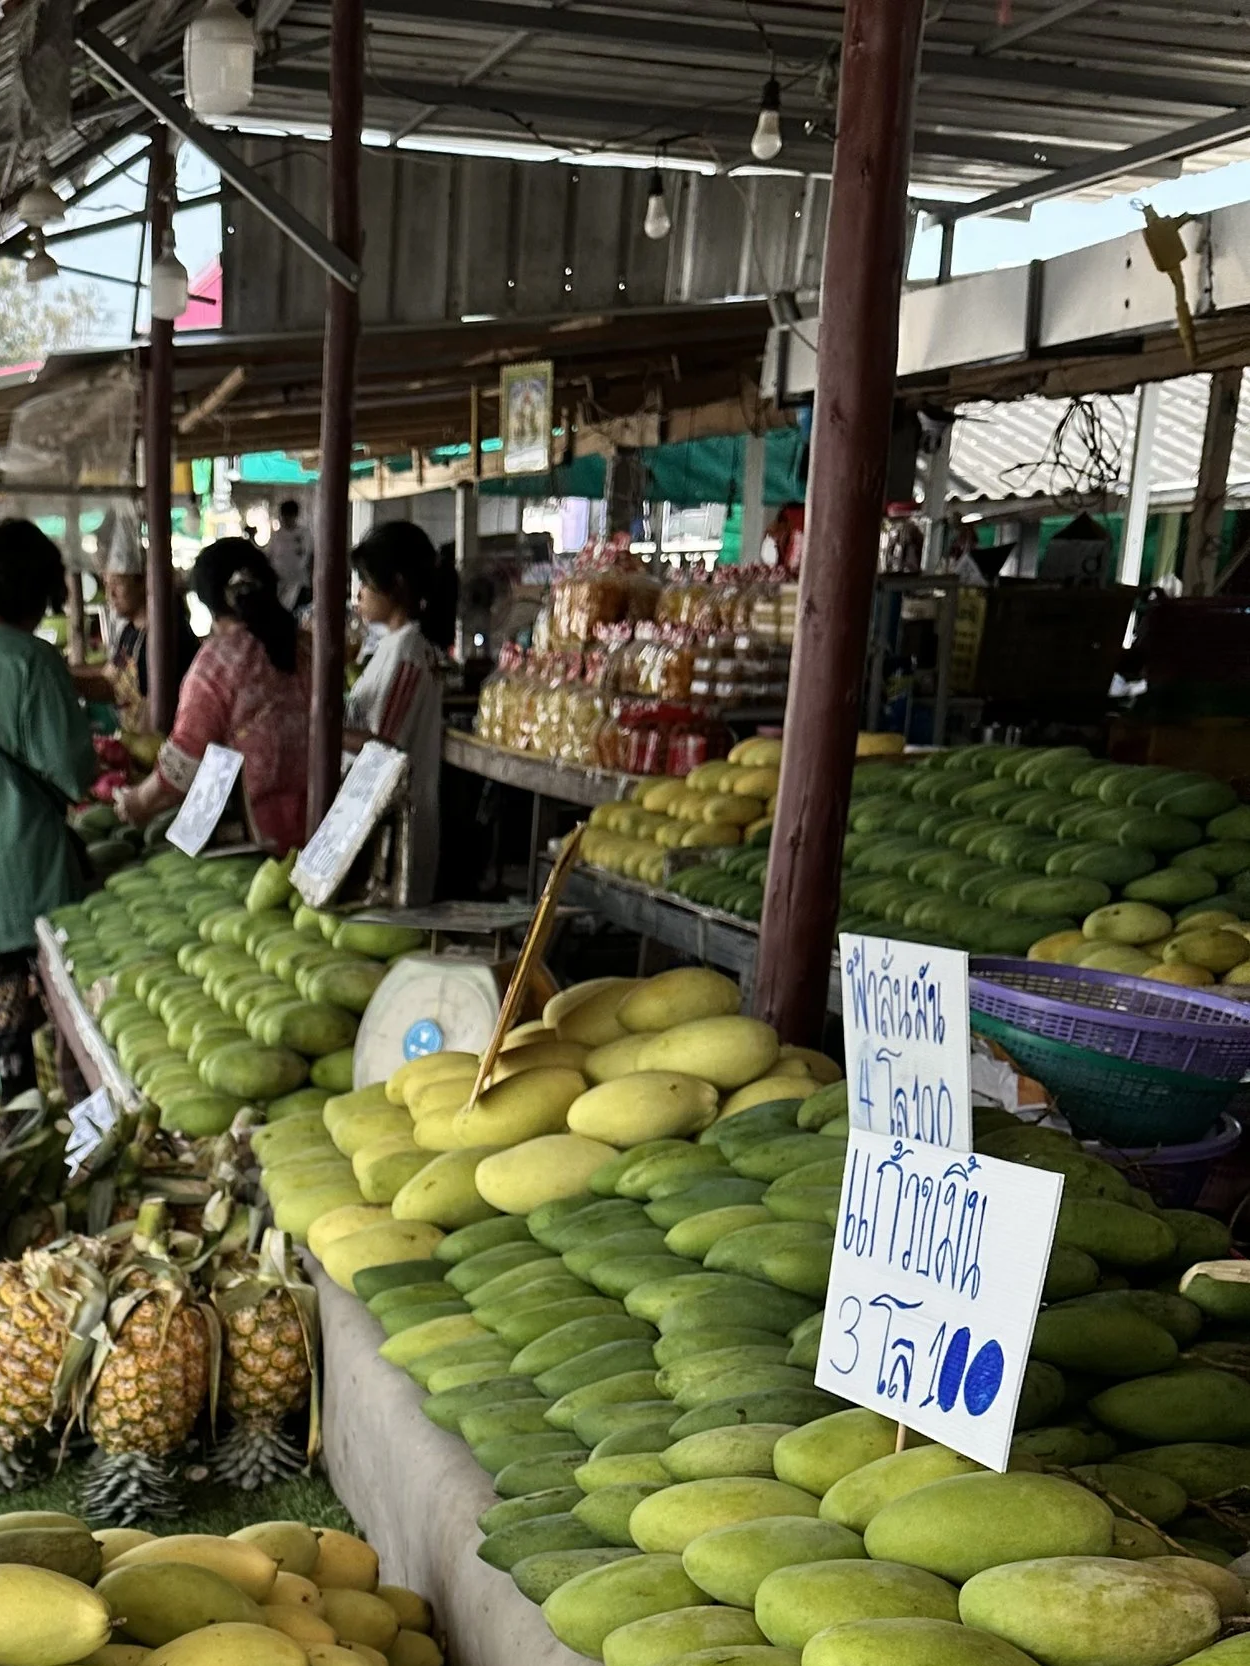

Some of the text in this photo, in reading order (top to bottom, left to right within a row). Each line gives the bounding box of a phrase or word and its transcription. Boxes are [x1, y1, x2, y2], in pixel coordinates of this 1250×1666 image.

[846, 938, 946, 1045] ฟ้าลั่นมัน
[859, 1057, 875, 1130] 4
[843, 1140, 988, 1300] แก้วขมิ้น
[830, 1293, 1005, 1417] 3 โล 100
